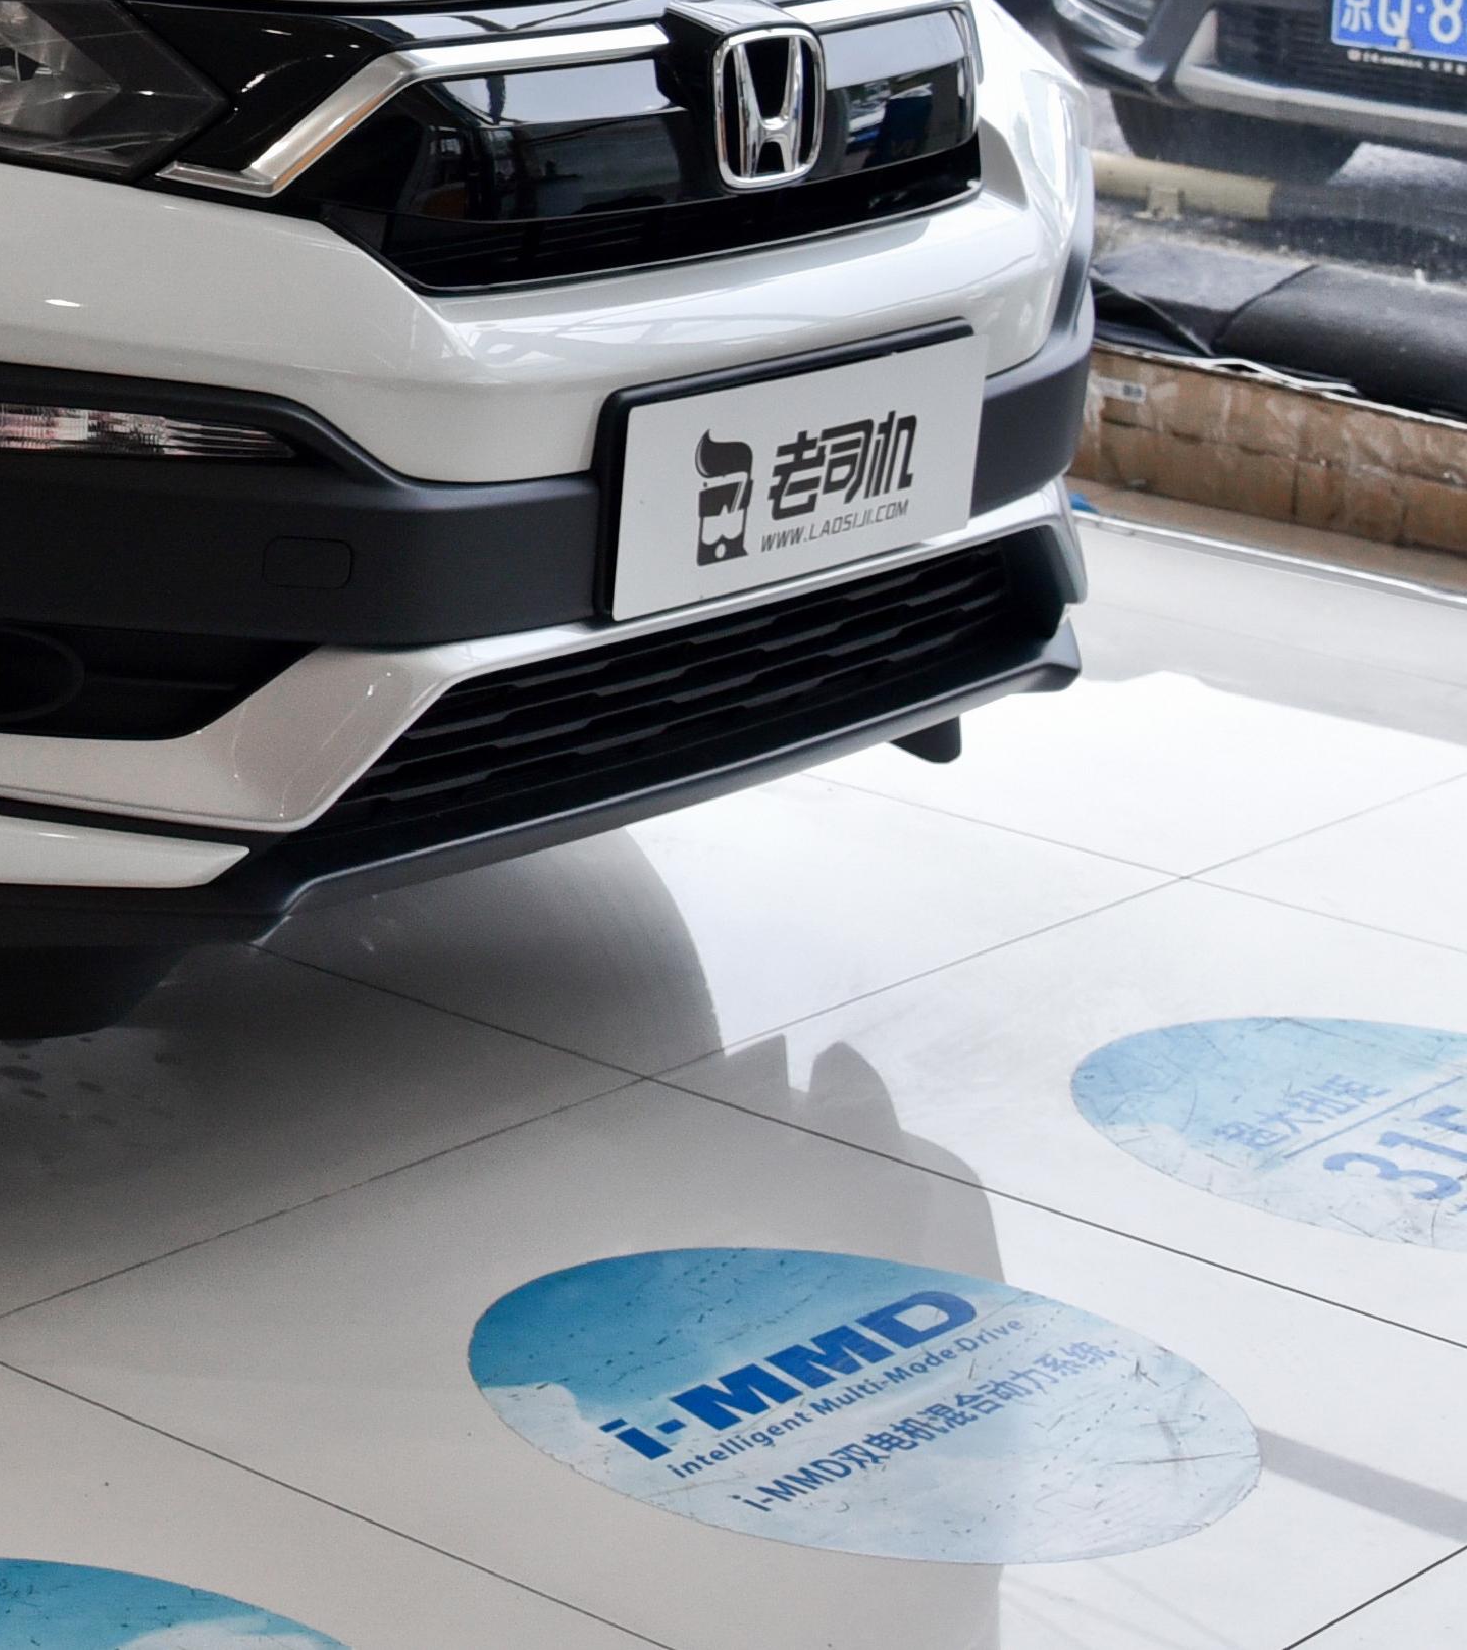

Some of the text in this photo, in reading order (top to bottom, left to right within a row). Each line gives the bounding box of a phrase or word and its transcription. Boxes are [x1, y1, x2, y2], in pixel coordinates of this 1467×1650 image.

[767, 410, 917, 521] 老司机
[599, 1289, 979, 1461] i-MMD
